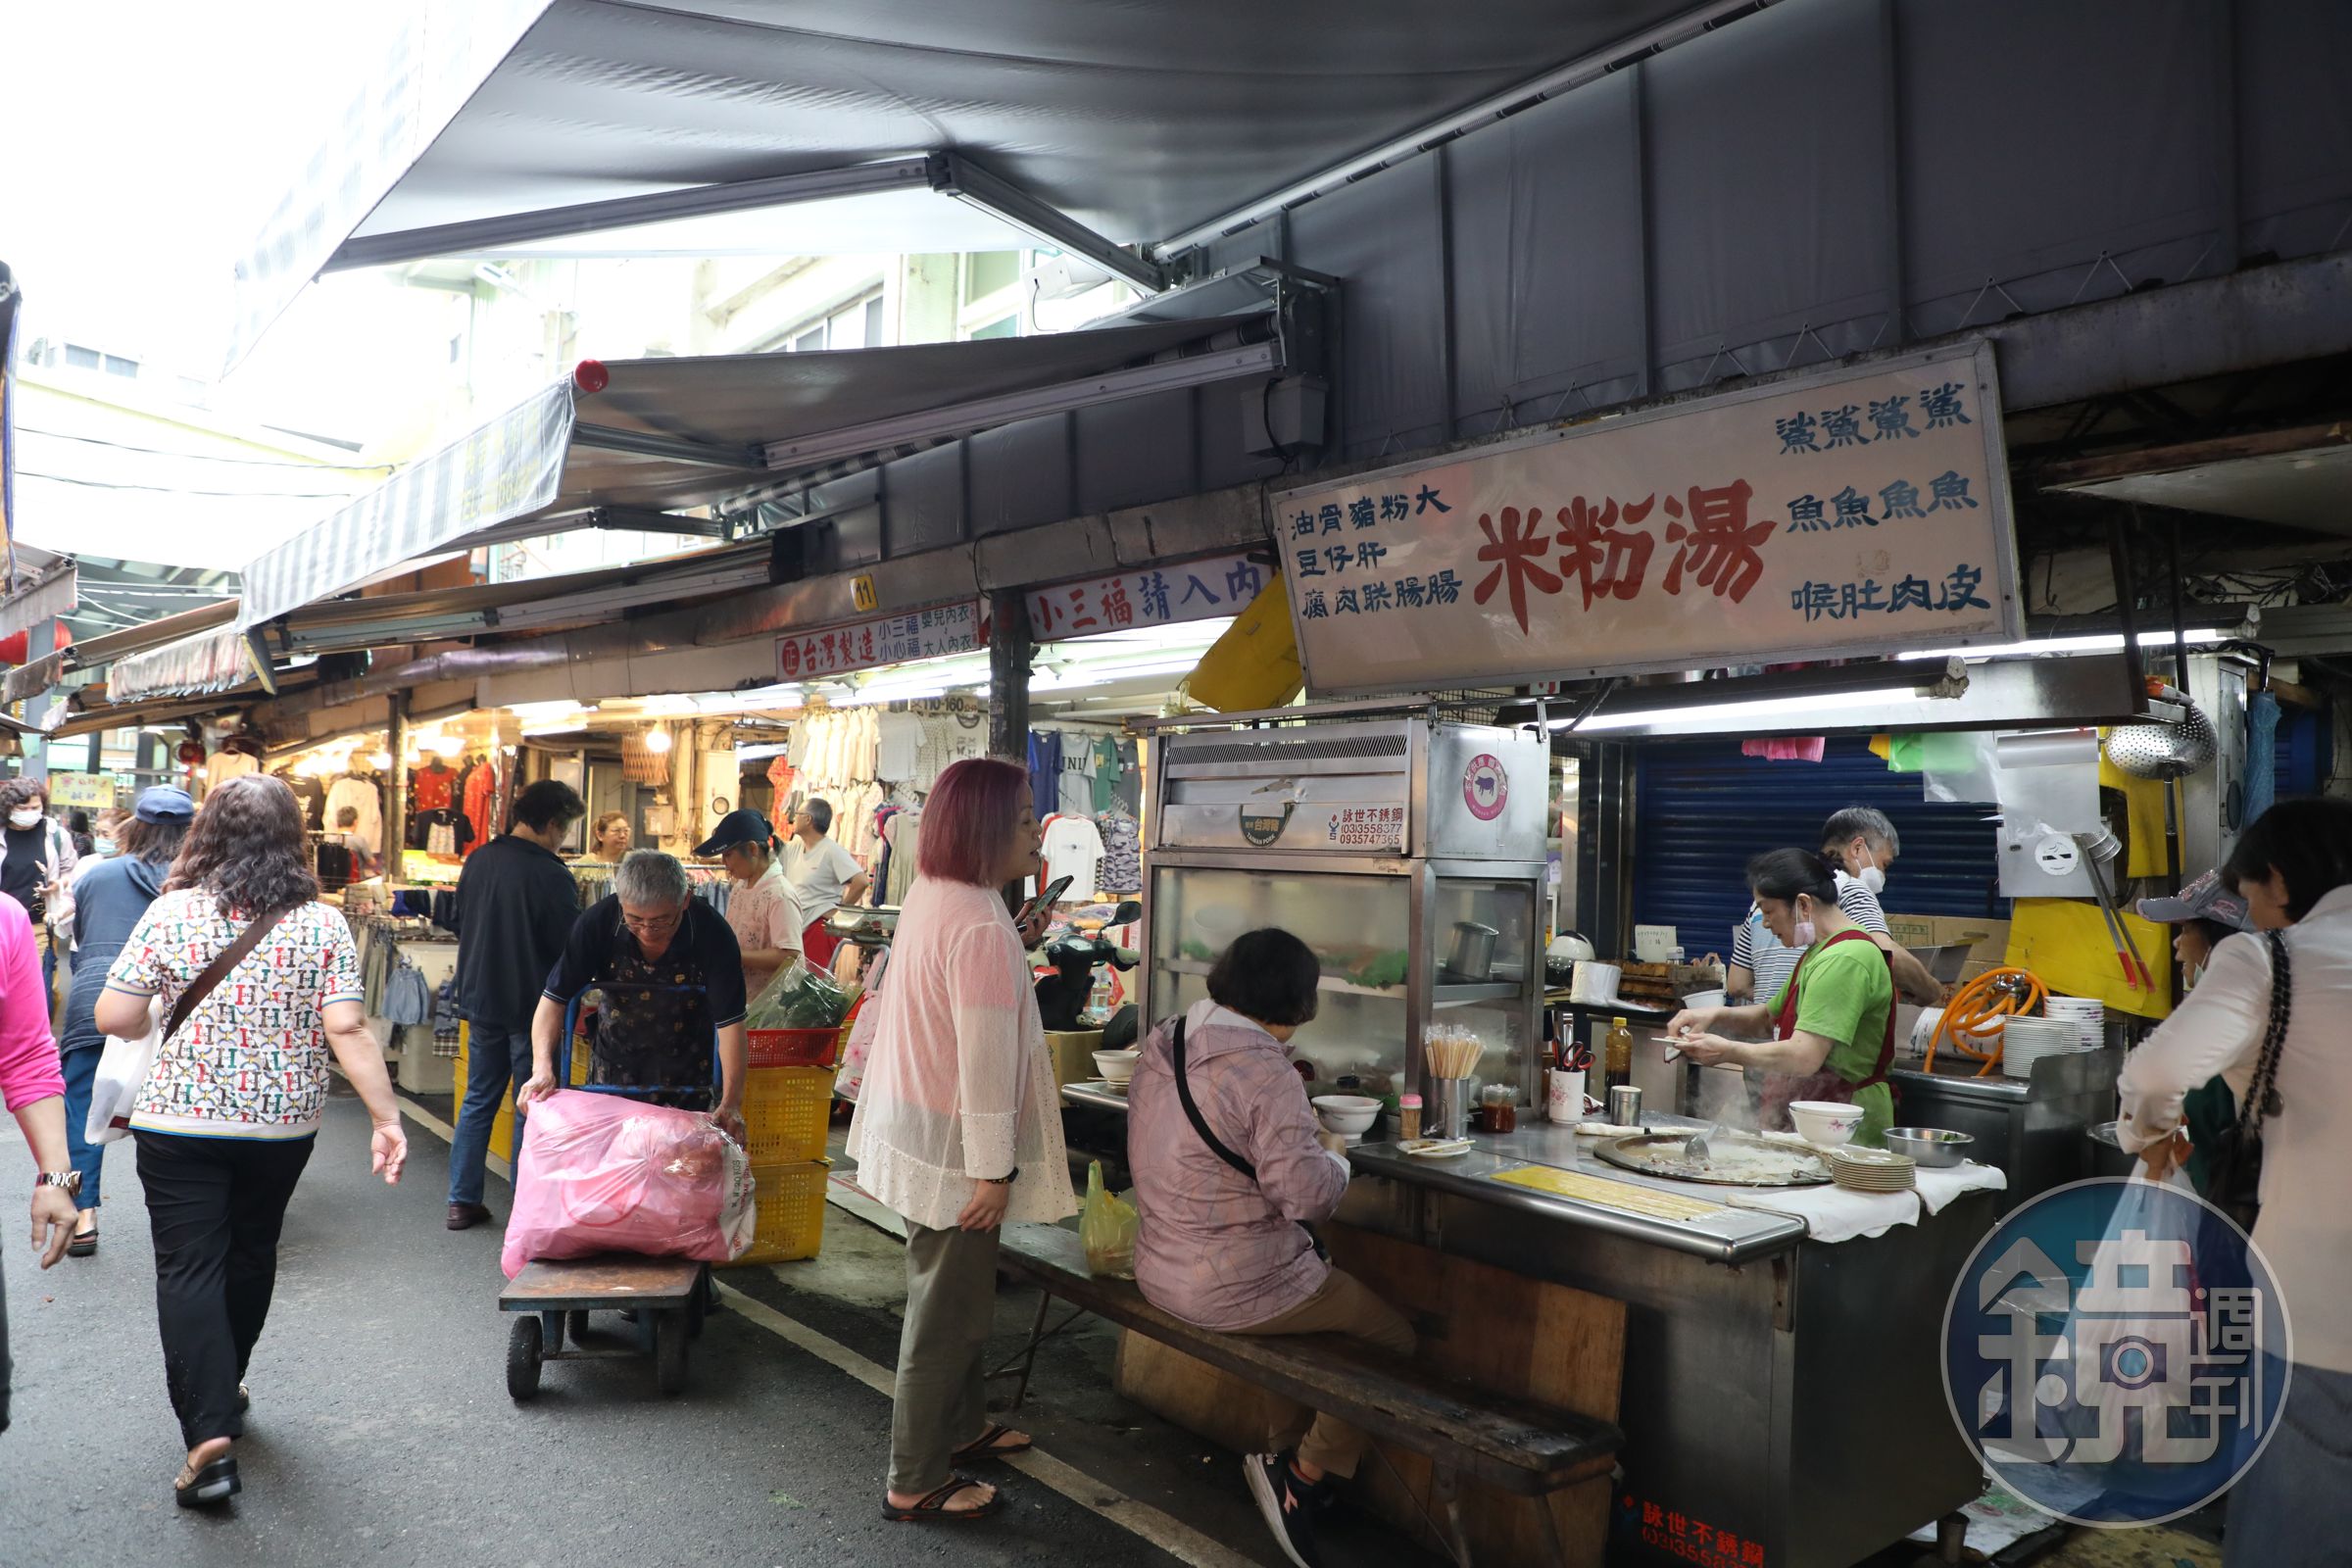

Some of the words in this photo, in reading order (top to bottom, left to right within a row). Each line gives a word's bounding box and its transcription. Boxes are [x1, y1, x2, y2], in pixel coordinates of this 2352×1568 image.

[1473, 478, 1778, 637] 米粉湯
[1341, 823, 1402, 834] (03)3558377
[1340, 834, 1400, 845] 0935747365
